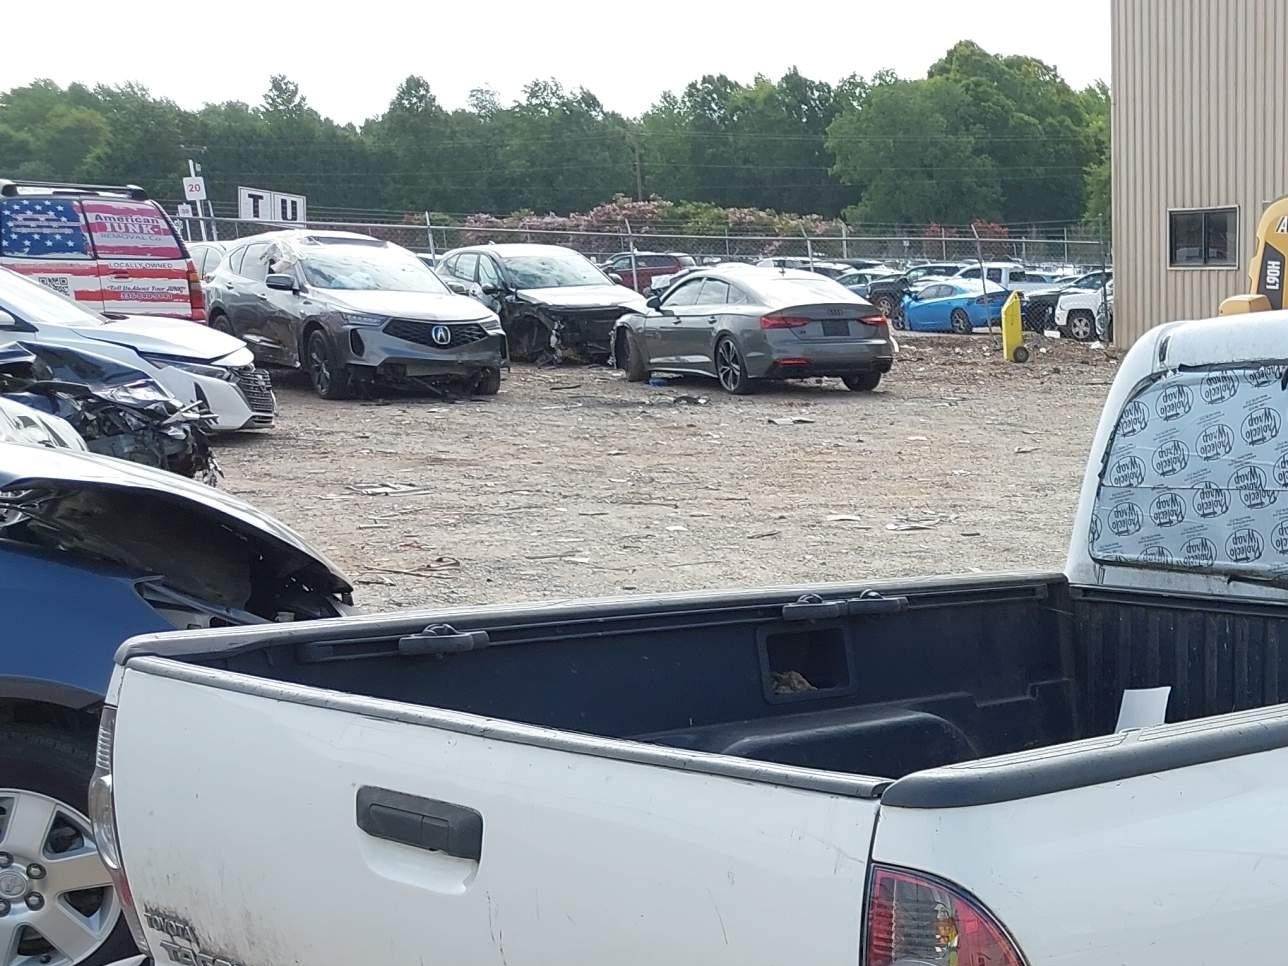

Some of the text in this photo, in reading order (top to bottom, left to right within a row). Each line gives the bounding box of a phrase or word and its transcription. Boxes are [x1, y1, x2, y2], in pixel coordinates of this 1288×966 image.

[188, 184, 200, 192] 20
[95, 214, 160, 224] American
[106, 222, 155, 234] JUNK
[1266, 260, 1280, 290] L90H
[1163, 384, 1186, 403] Wrap
[1248, 408, 1274, 427] Wrap
[1203, 424, 1228, 443] Wrap
[1246, 415, 1279, 446] Protecto
[1200, 432, 1232, 462] Protecto
[1116, 457, 1139, 474] Wrap
[1114, 502, 1137, 518] Wrap
[1156, 493, 1179, 508] Wrap
[1197, 492, 1229, 518] Protecto
[1112, 510, 1142, 536] Protecto
[1154, 500, 1184, 528] Protecto
[1233, 529, 1258, 546] Wrap
[1230, 538, 1262, 562] Protecto
[144, 912, 196, 942] TOYOTA
